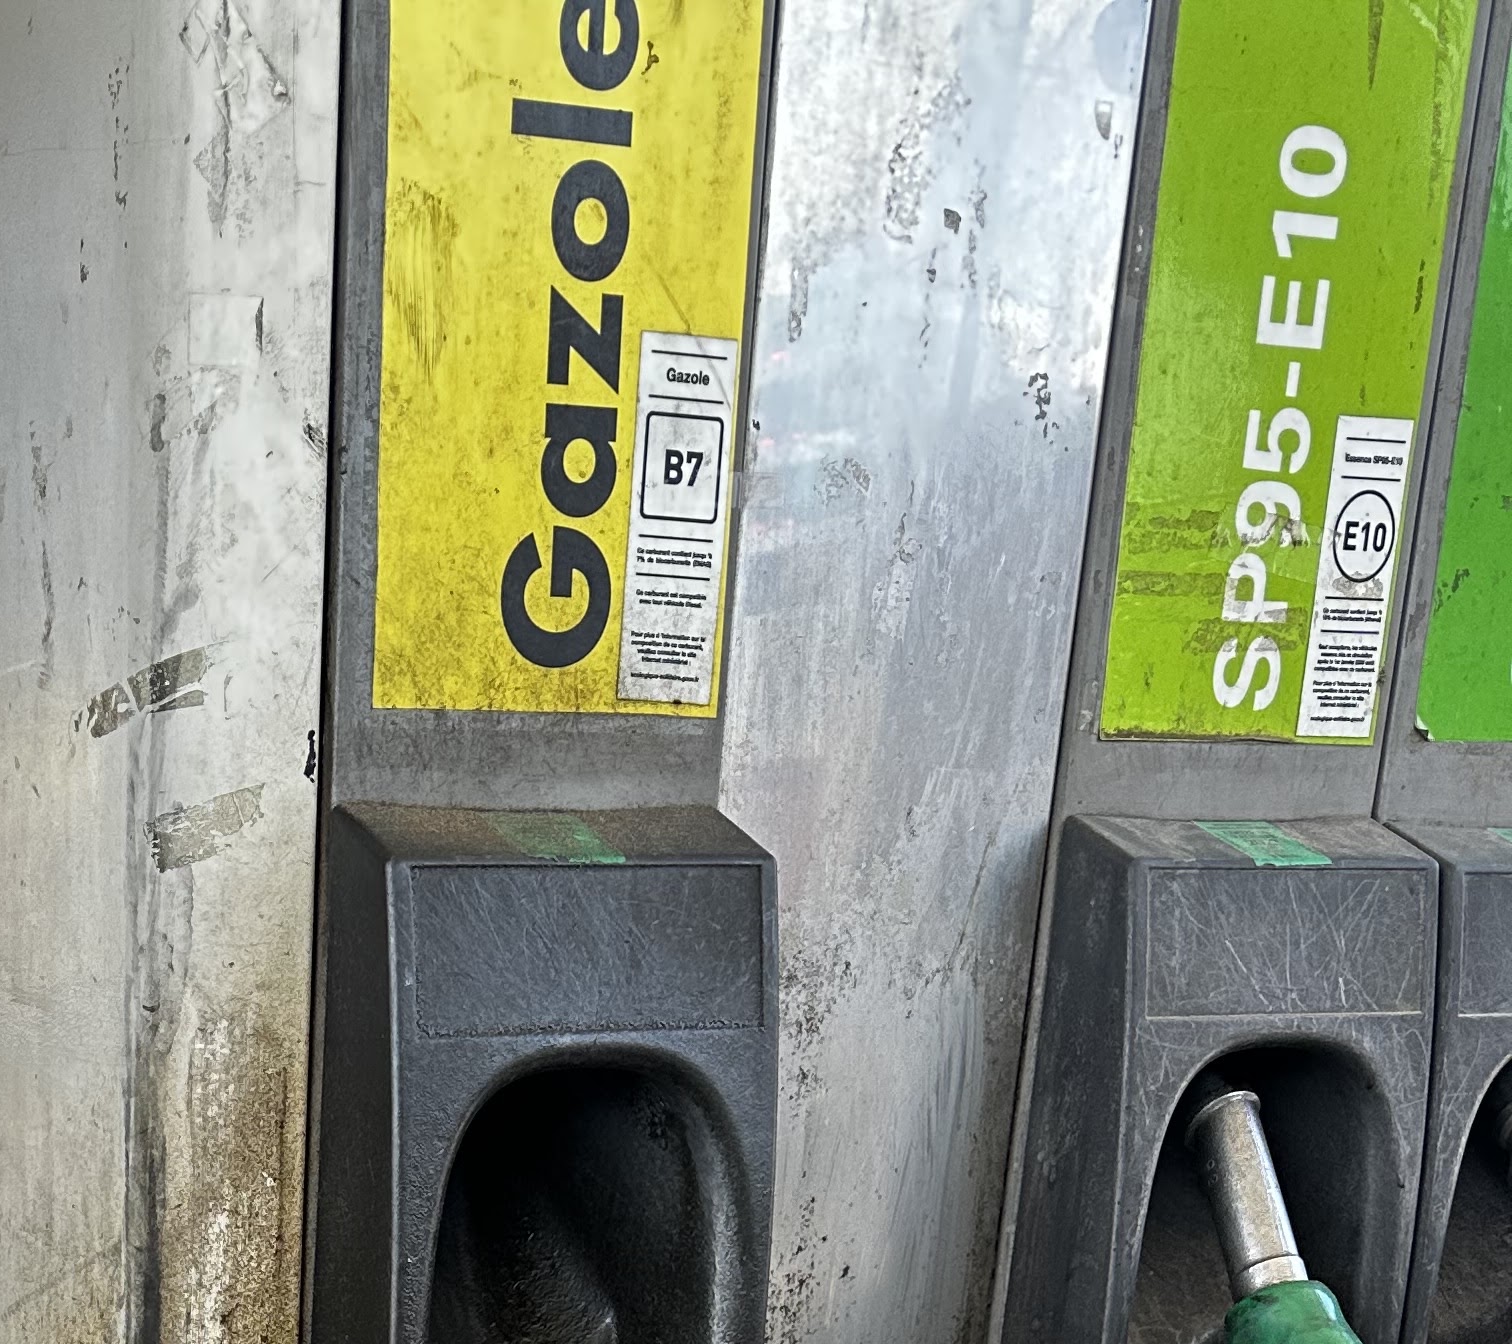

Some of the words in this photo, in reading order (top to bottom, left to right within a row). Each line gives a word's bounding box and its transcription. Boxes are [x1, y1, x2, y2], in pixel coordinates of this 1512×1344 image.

[501, 0, 640, 669] Gazole
[666, 367, 710, 386] Gazole
[1212, 125, 1348, 713] SP95-E10
[663, 448, 704, 487] B7
[1342, 520, 1387, 553] E10
